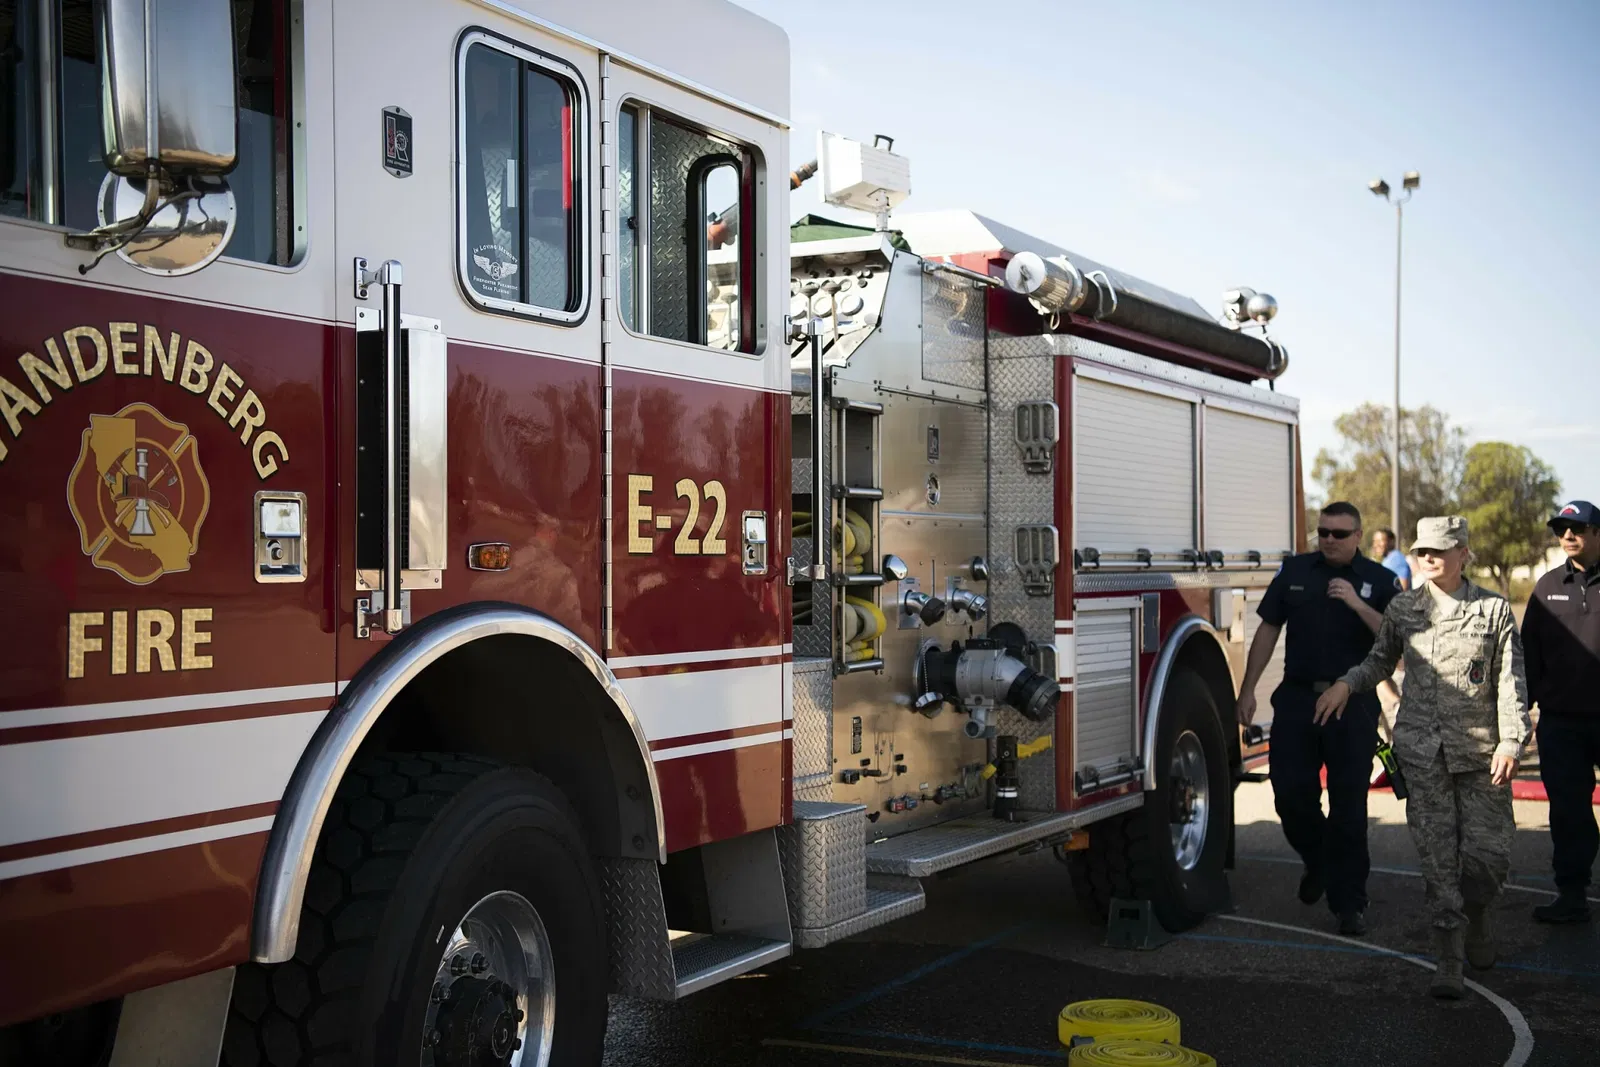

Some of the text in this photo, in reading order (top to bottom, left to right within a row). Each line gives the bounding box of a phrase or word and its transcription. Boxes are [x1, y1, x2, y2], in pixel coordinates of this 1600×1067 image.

[0, 321, 289, 480] ANDENBERG
[628, 474, 727, 555] E-22
[67, 608, 214, 679] FIRE
